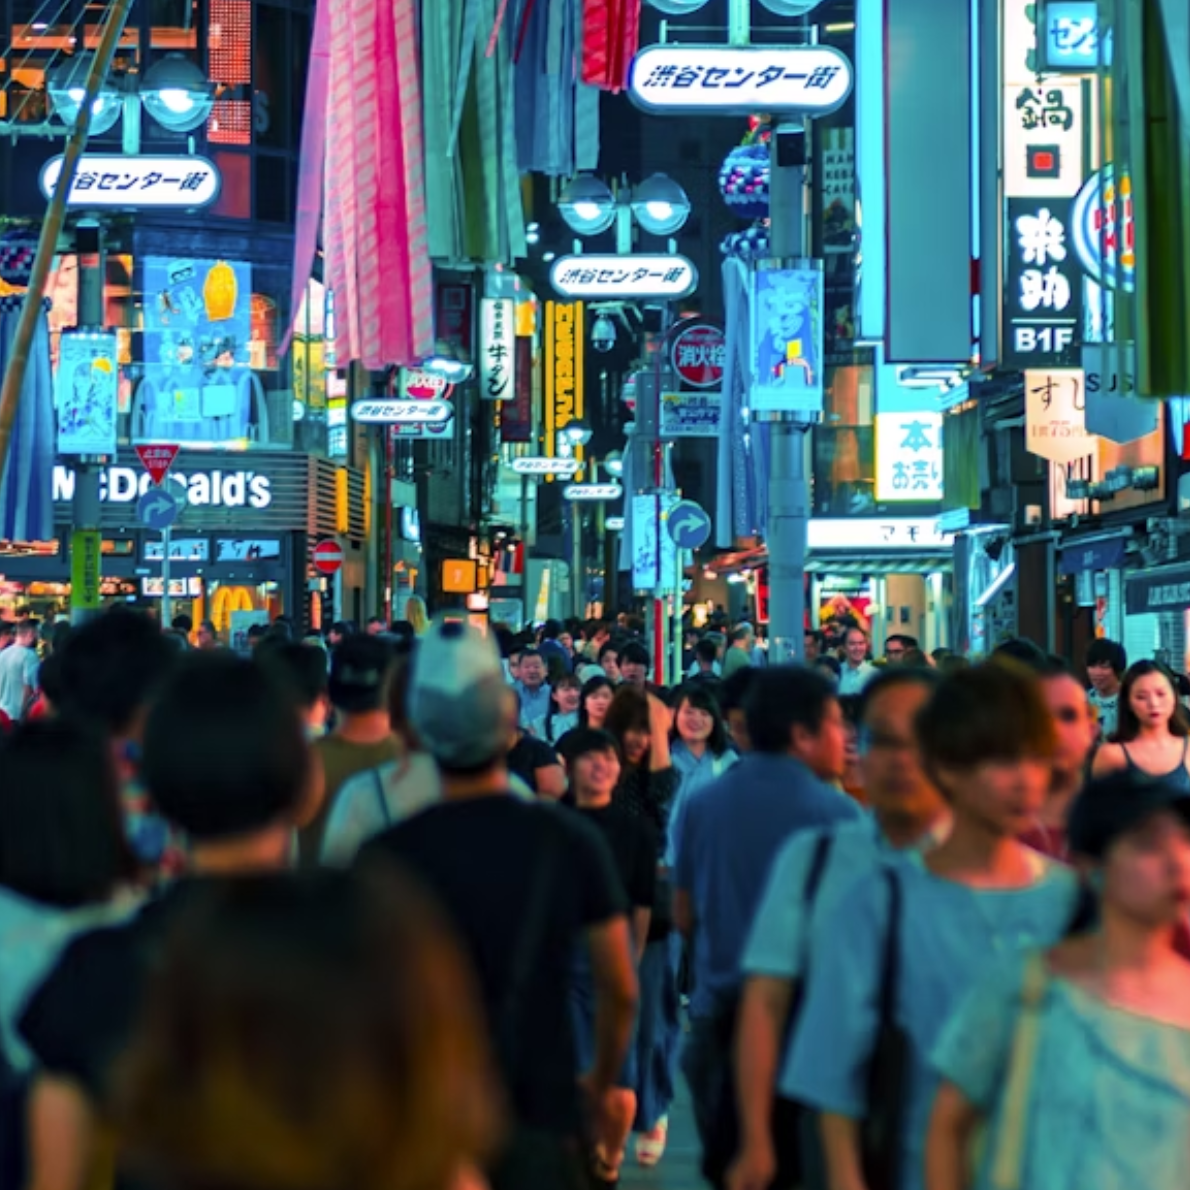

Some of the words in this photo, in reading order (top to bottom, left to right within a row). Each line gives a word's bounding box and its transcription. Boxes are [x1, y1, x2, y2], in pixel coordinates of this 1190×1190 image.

[642, 63, 841, 90] 渋谷センター街
[1015, 87, 1074, 132] 鍋
[51, 170, 209, 193] 谷センター街
[560, 266, 686, 284] 渋谷センター街
[1014, 326, 1074, 353] B1F
[487, 342, 509, 397] 牛タン
[1030, 374, 1086, 412] すし
